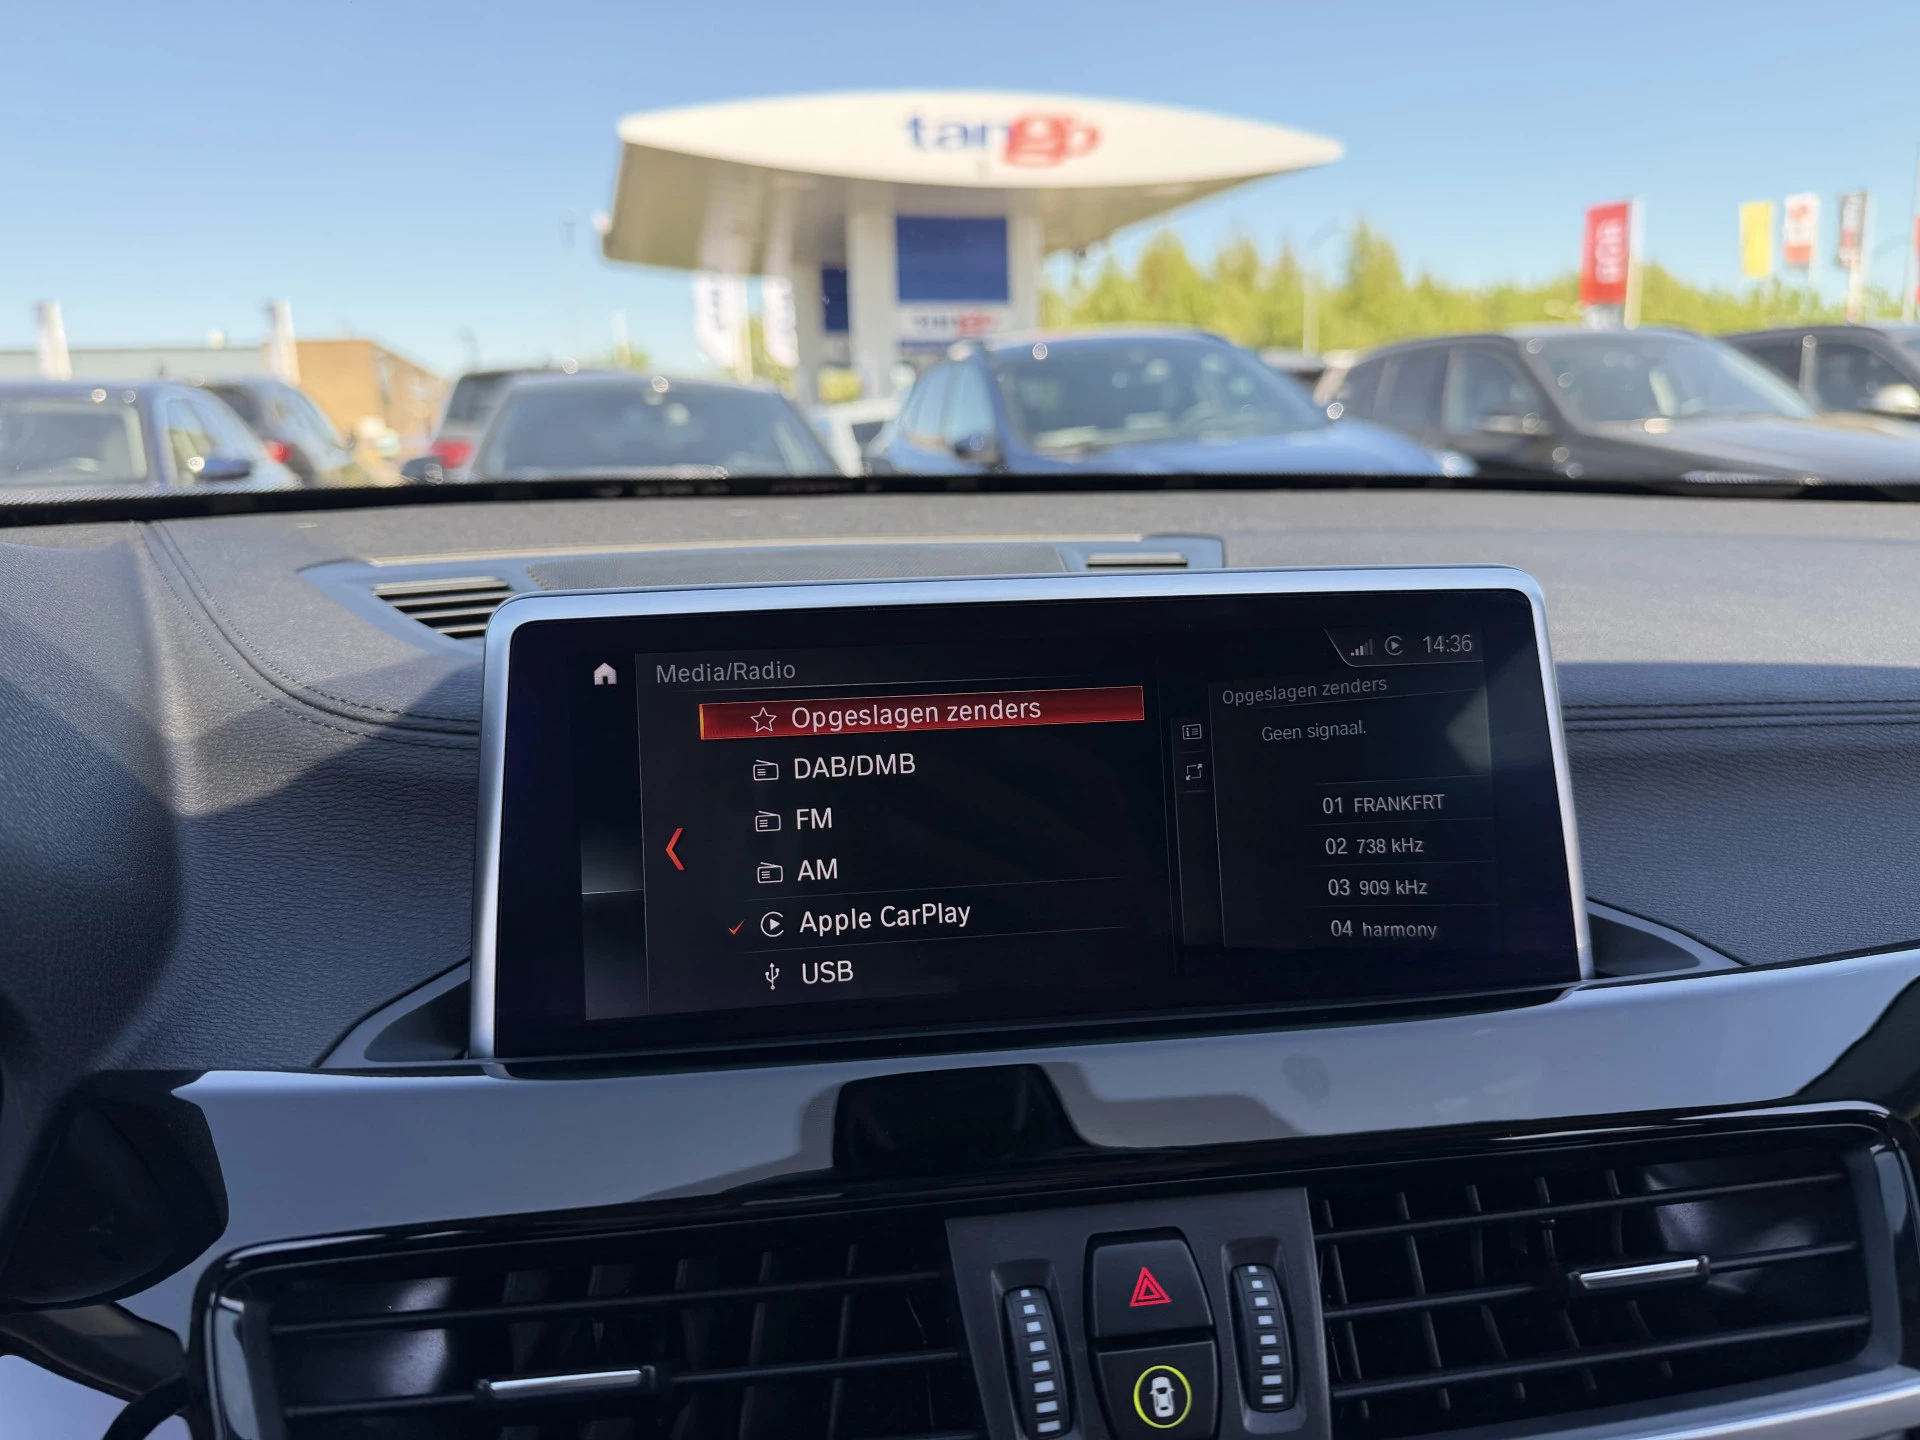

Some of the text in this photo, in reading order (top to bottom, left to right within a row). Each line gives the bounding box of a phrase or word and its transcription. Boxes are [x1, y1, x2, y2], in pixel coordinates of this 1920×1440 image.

[906, 113, 1102, 167] tango
[1422, 633, 1473, 654] 14:36
[655, 660, 796, 684] Media/Radio
[1222, 677, 1388, 705] Opgeslagen zenders
[791, 698, 1042, 732] Opgeslagen zenders
[1261, 719, 1367, 742] Geen signaal.
[793, 752, 916, 780] DAB/DMB
[1322, 793, 1446, 815] 01 FRANKFRT
[796, 808, 833, 830] FM
[1325, 837, 1425, 855] 02 738 kHz
[797, 858, 839, 881] AM
[1327, 878, 1428, 896] 03 909 kHz
[799, 902, 971, 936] Apple CarPlay
[1330, 919, 1438, 939] 04 harmony
[801, 961, 854, 985] USB
